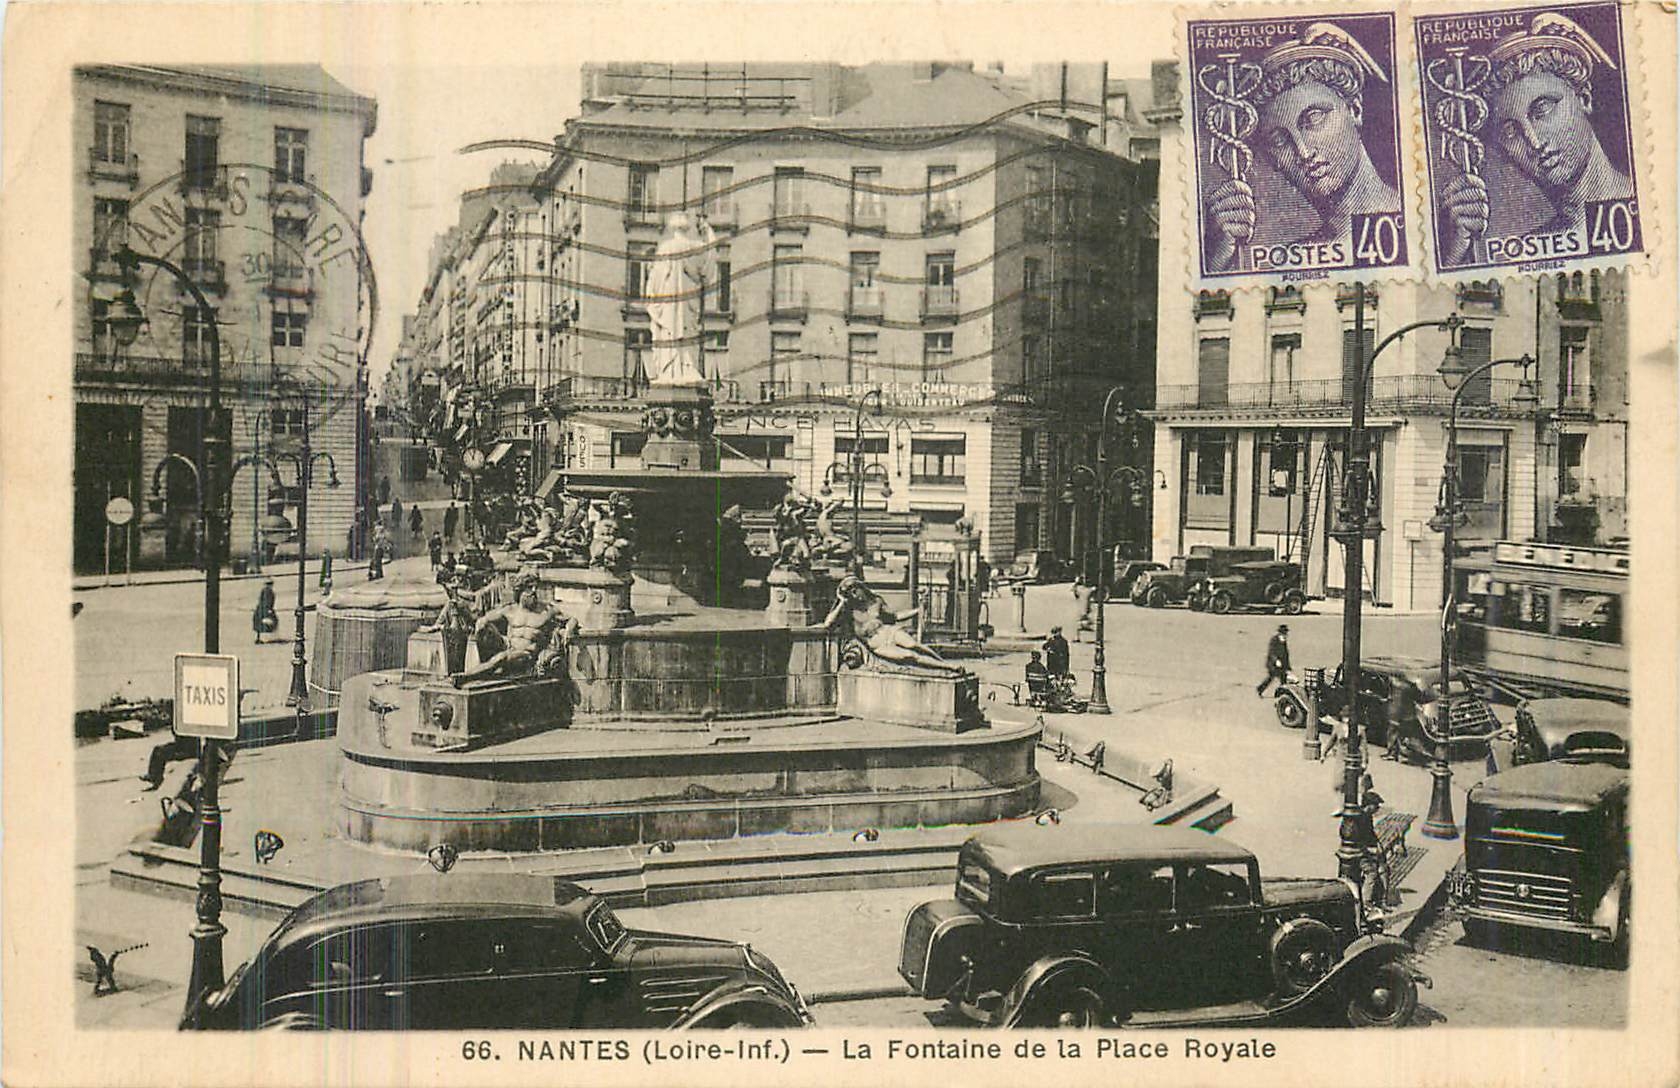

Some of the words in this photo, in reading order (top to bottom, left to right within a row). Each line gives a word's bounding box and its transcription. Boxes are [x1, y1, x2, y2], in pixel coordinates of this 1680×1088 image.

[1252, 243, 1346, 268] POSTES
[1487, 232, 1581, 260] POSTES
[834, 416, 937, 431] HAVAS
[185, 685, 225, 706] TAXIS
